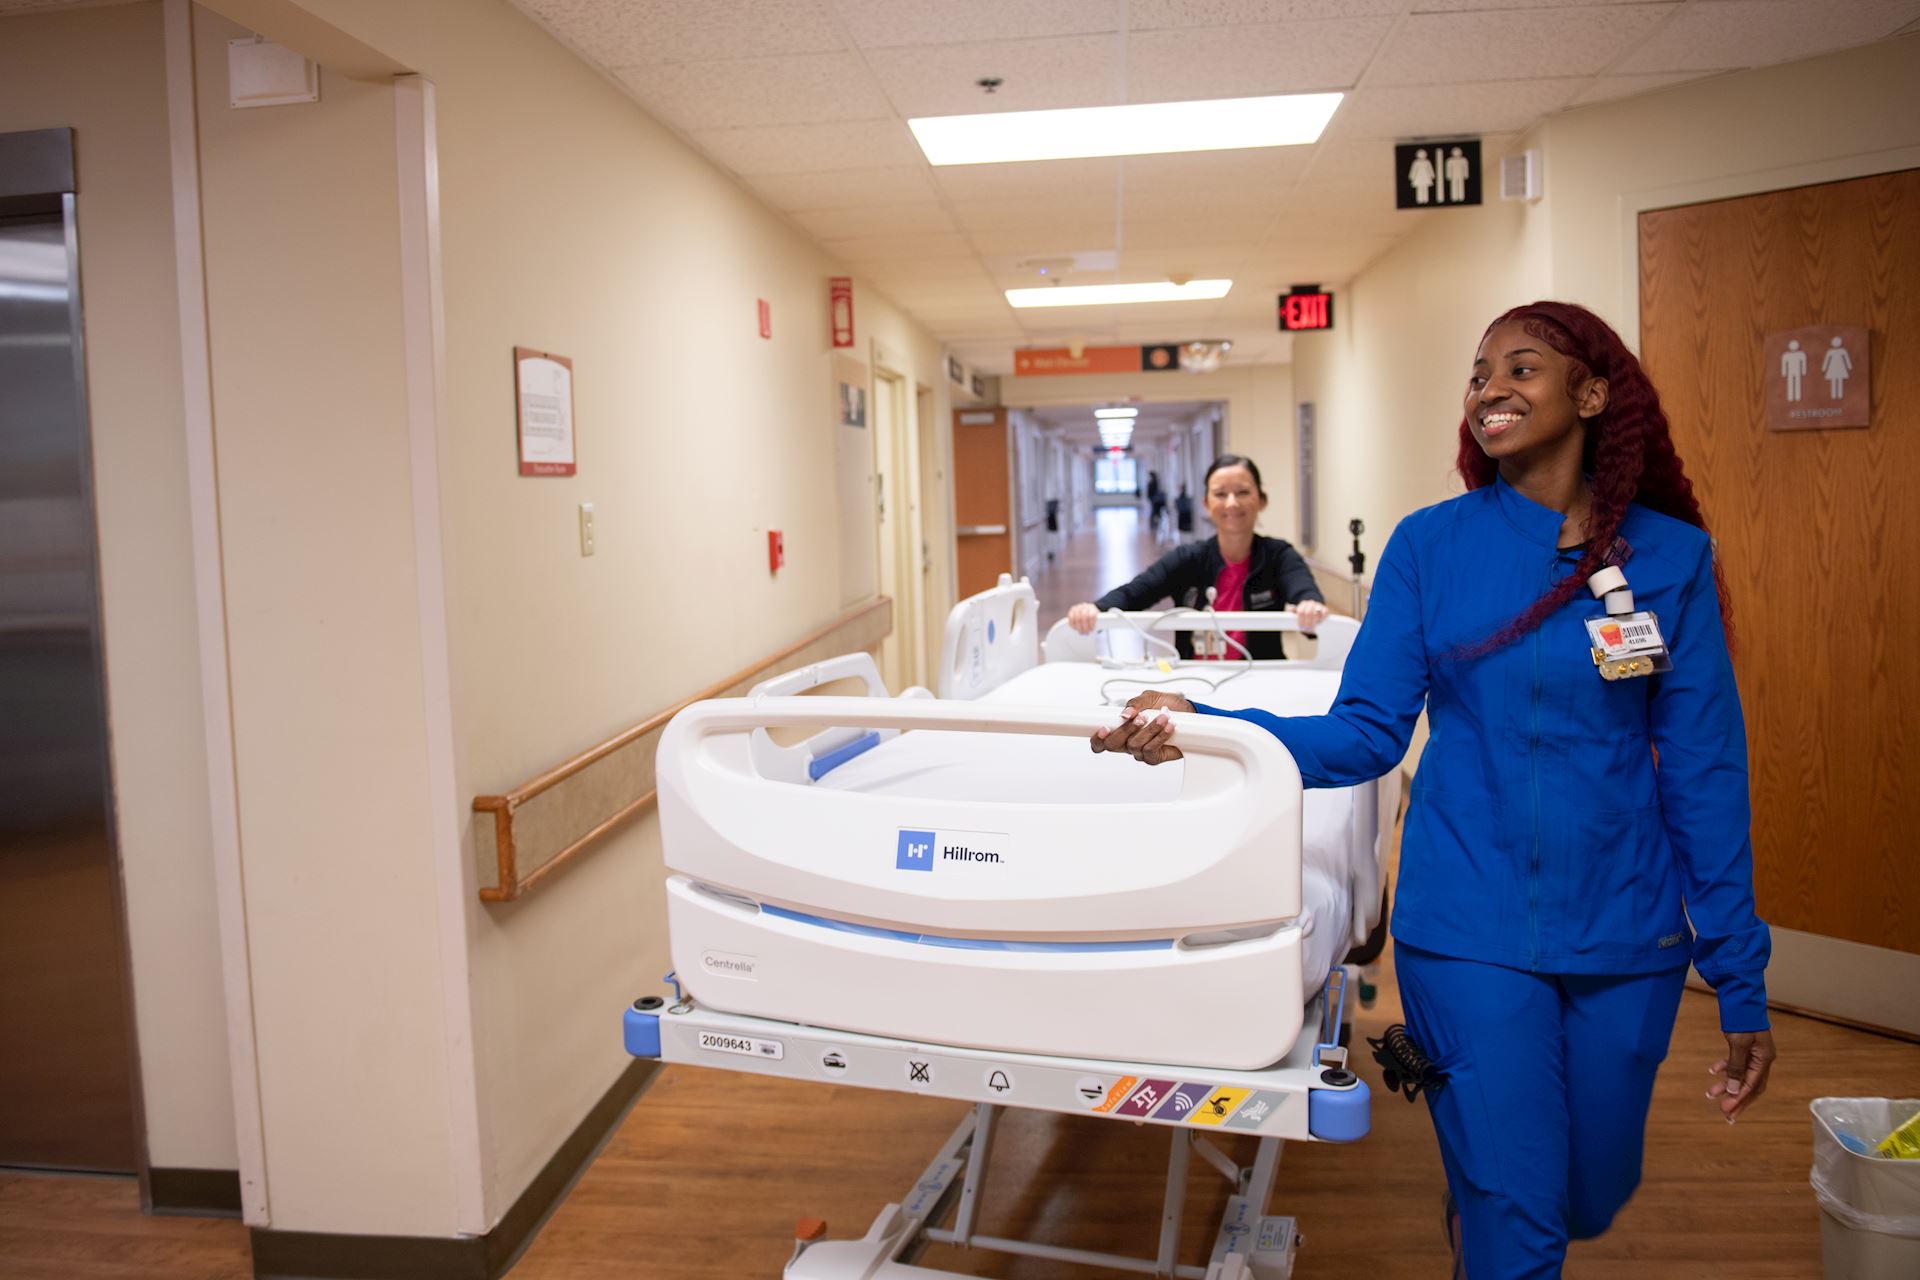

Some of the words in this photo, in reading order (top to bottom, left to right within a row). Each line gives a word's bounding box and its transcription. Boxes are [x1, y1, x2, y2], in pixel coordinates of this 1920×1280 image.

[1286, 294, 1328, 329] EXIT
[943, 846, 1000, 863] Hillrom
[705, 956, 753, 973] Centrella
[702, 1034, 751, 1051] 2009643
